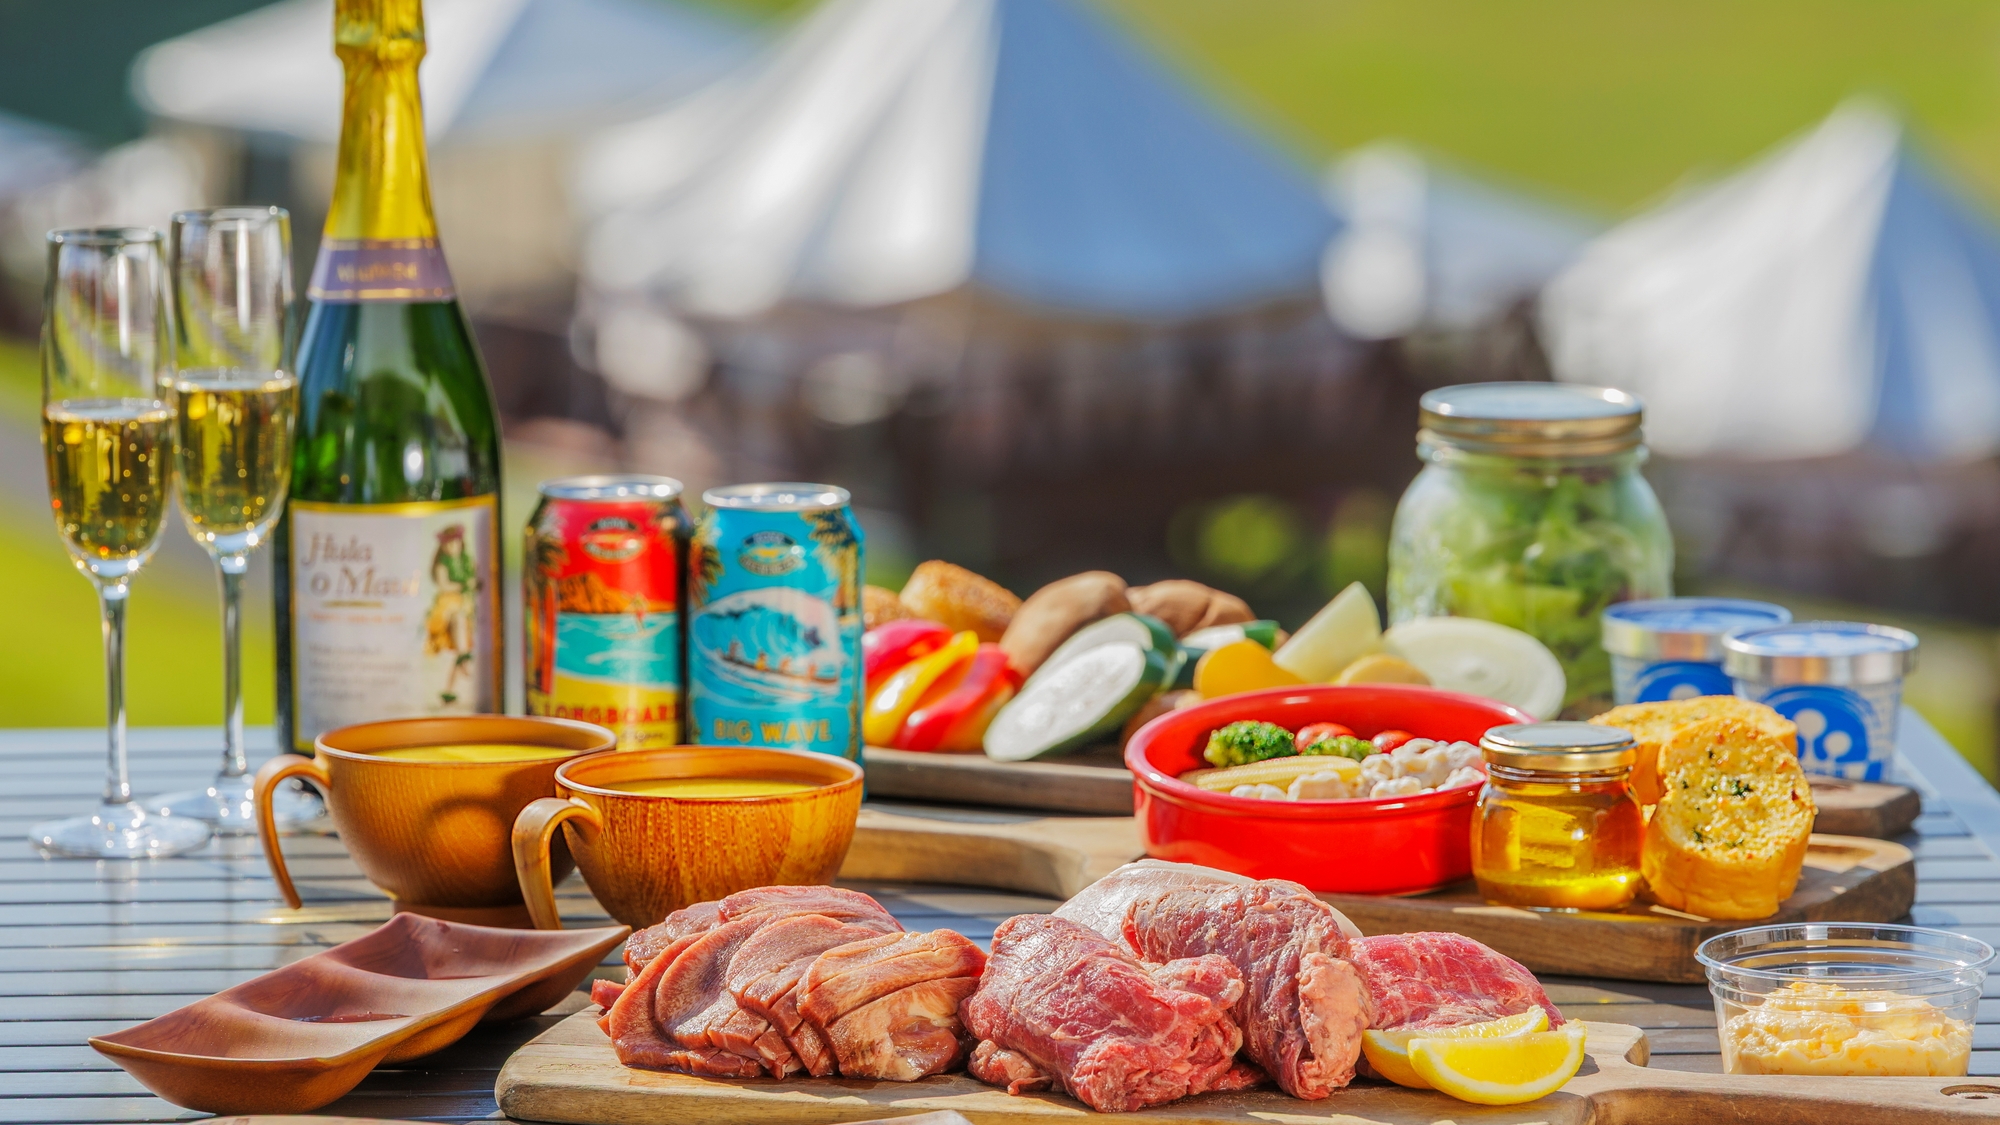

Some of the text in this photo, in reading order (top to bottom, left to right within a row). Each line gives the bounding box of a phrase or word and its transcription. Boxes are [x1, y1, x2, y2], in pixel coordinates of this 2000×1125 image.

[301, 532, 373, 569] Hula
[714, 718, 833, 743] BIG WAVE
